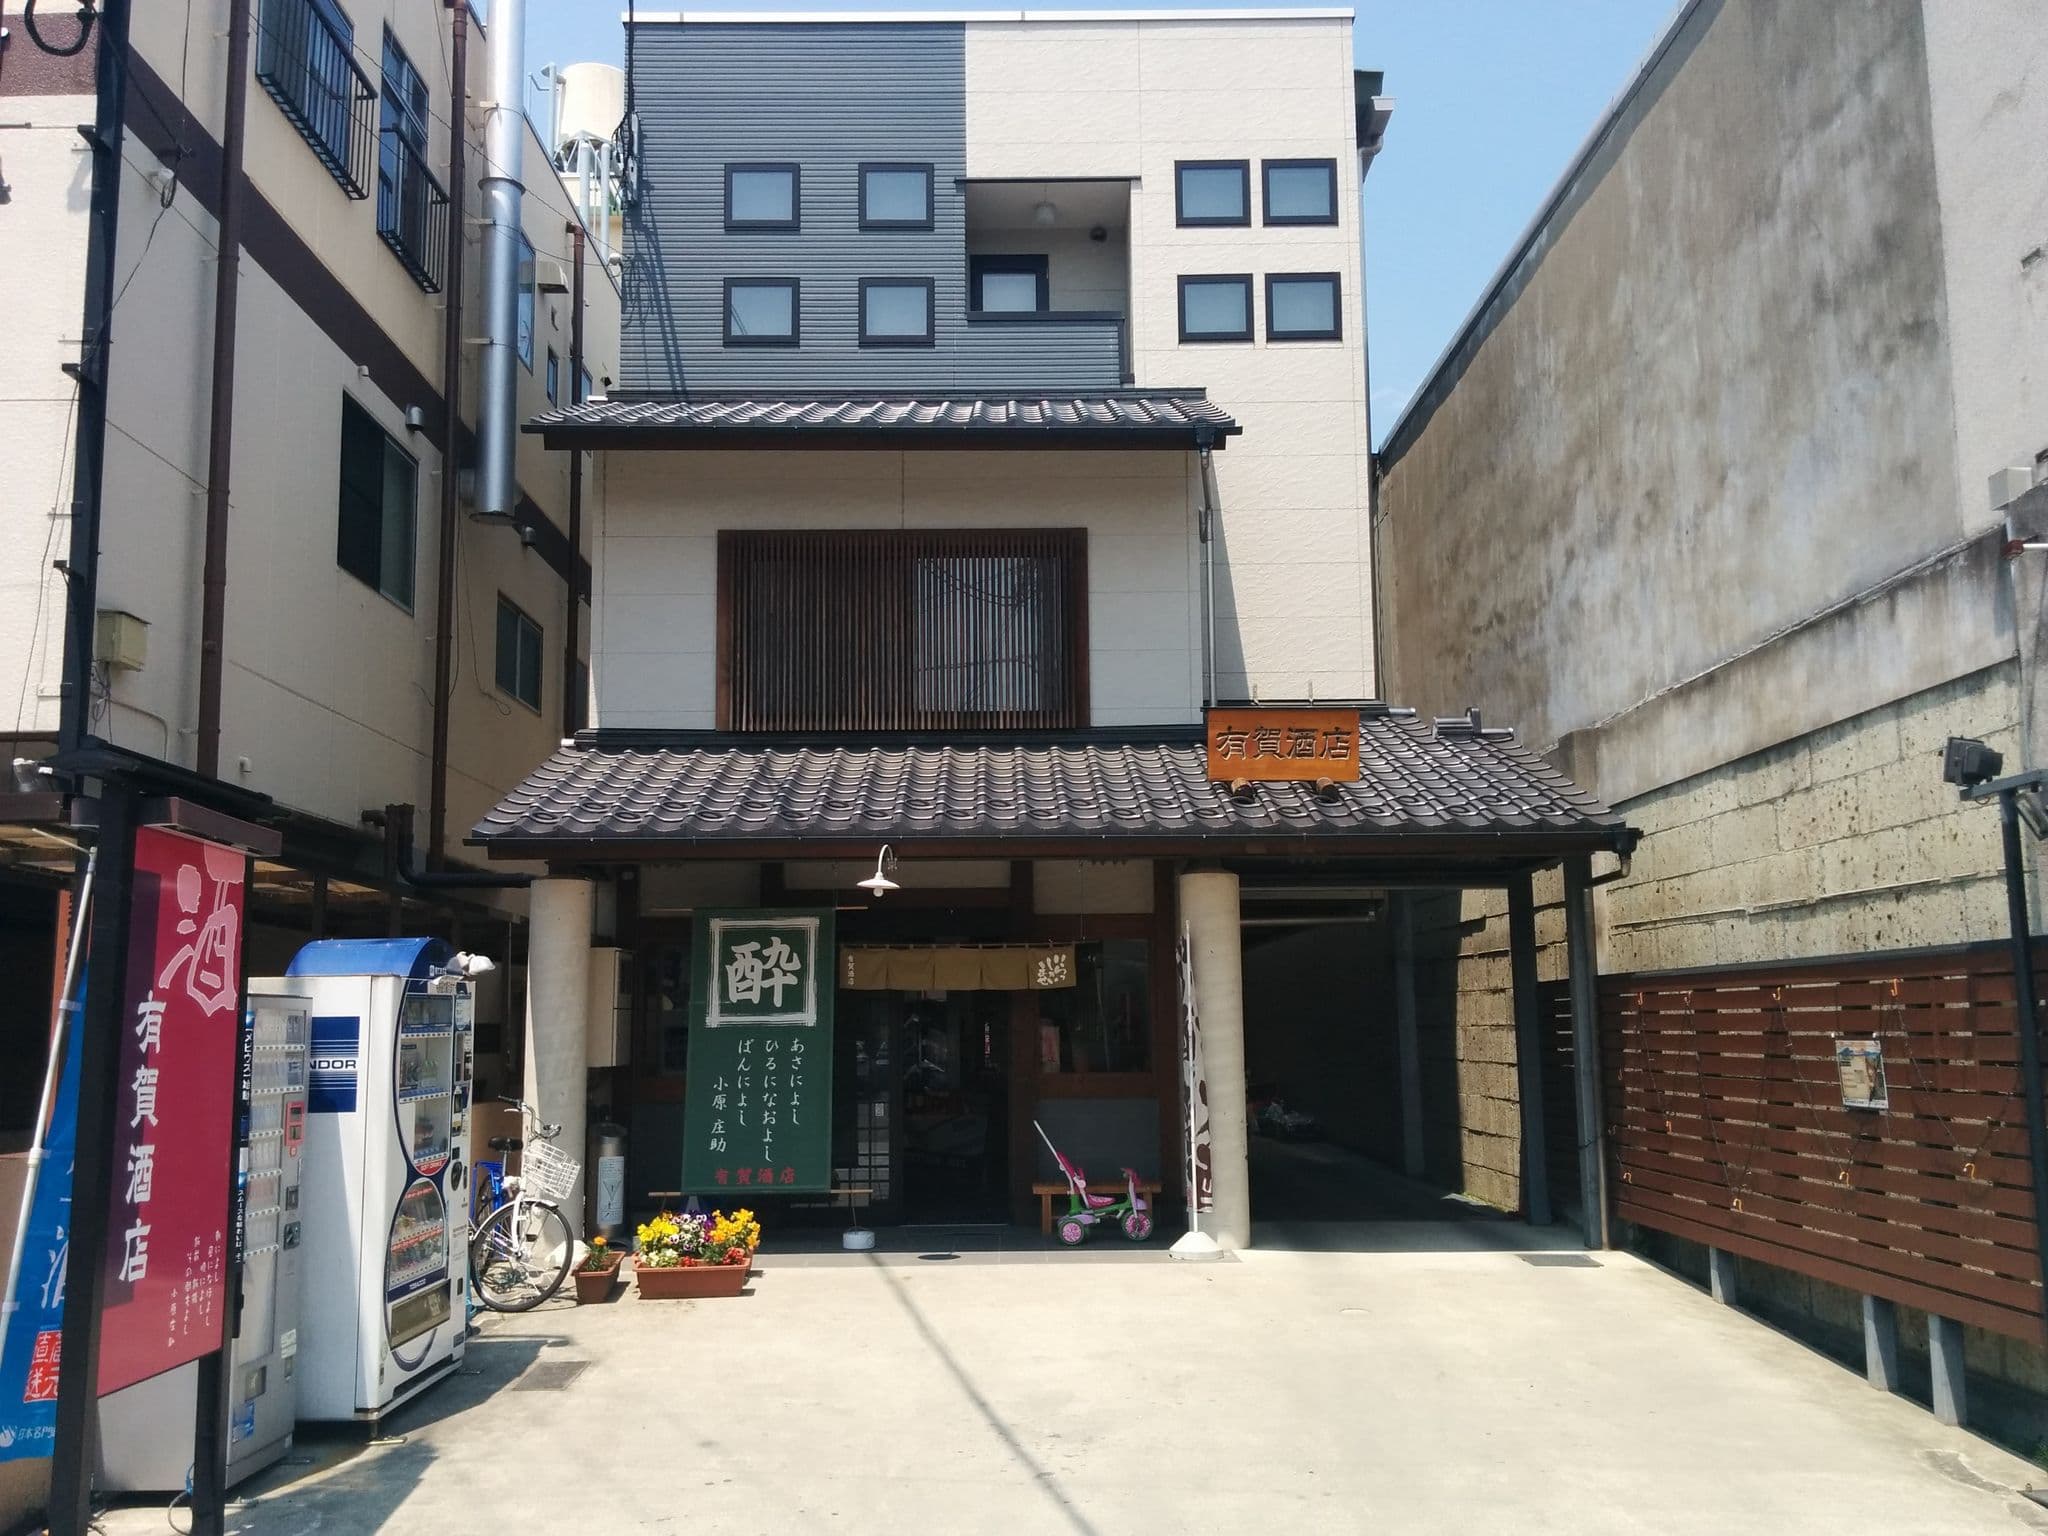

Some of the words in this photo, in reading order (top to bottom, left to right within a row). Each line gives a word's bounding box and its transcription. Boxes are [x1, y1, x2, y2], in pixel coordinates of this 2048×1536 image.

[1216, 726, 1351, 761] 有賀酒店
[726, 936, 801, 1007] 酔
[709, 1076, 729, 1153] 小原庄助
[737, 1038, 753, 1127] ばんによし
[762, 1039, 779, 1163] ひるになおよし
[790, 1037, 805, 1126] あさによし
[117, 990, 167, 1283] 有賀酒店
[715, 1167, 796, 1186] 有賀酒店
